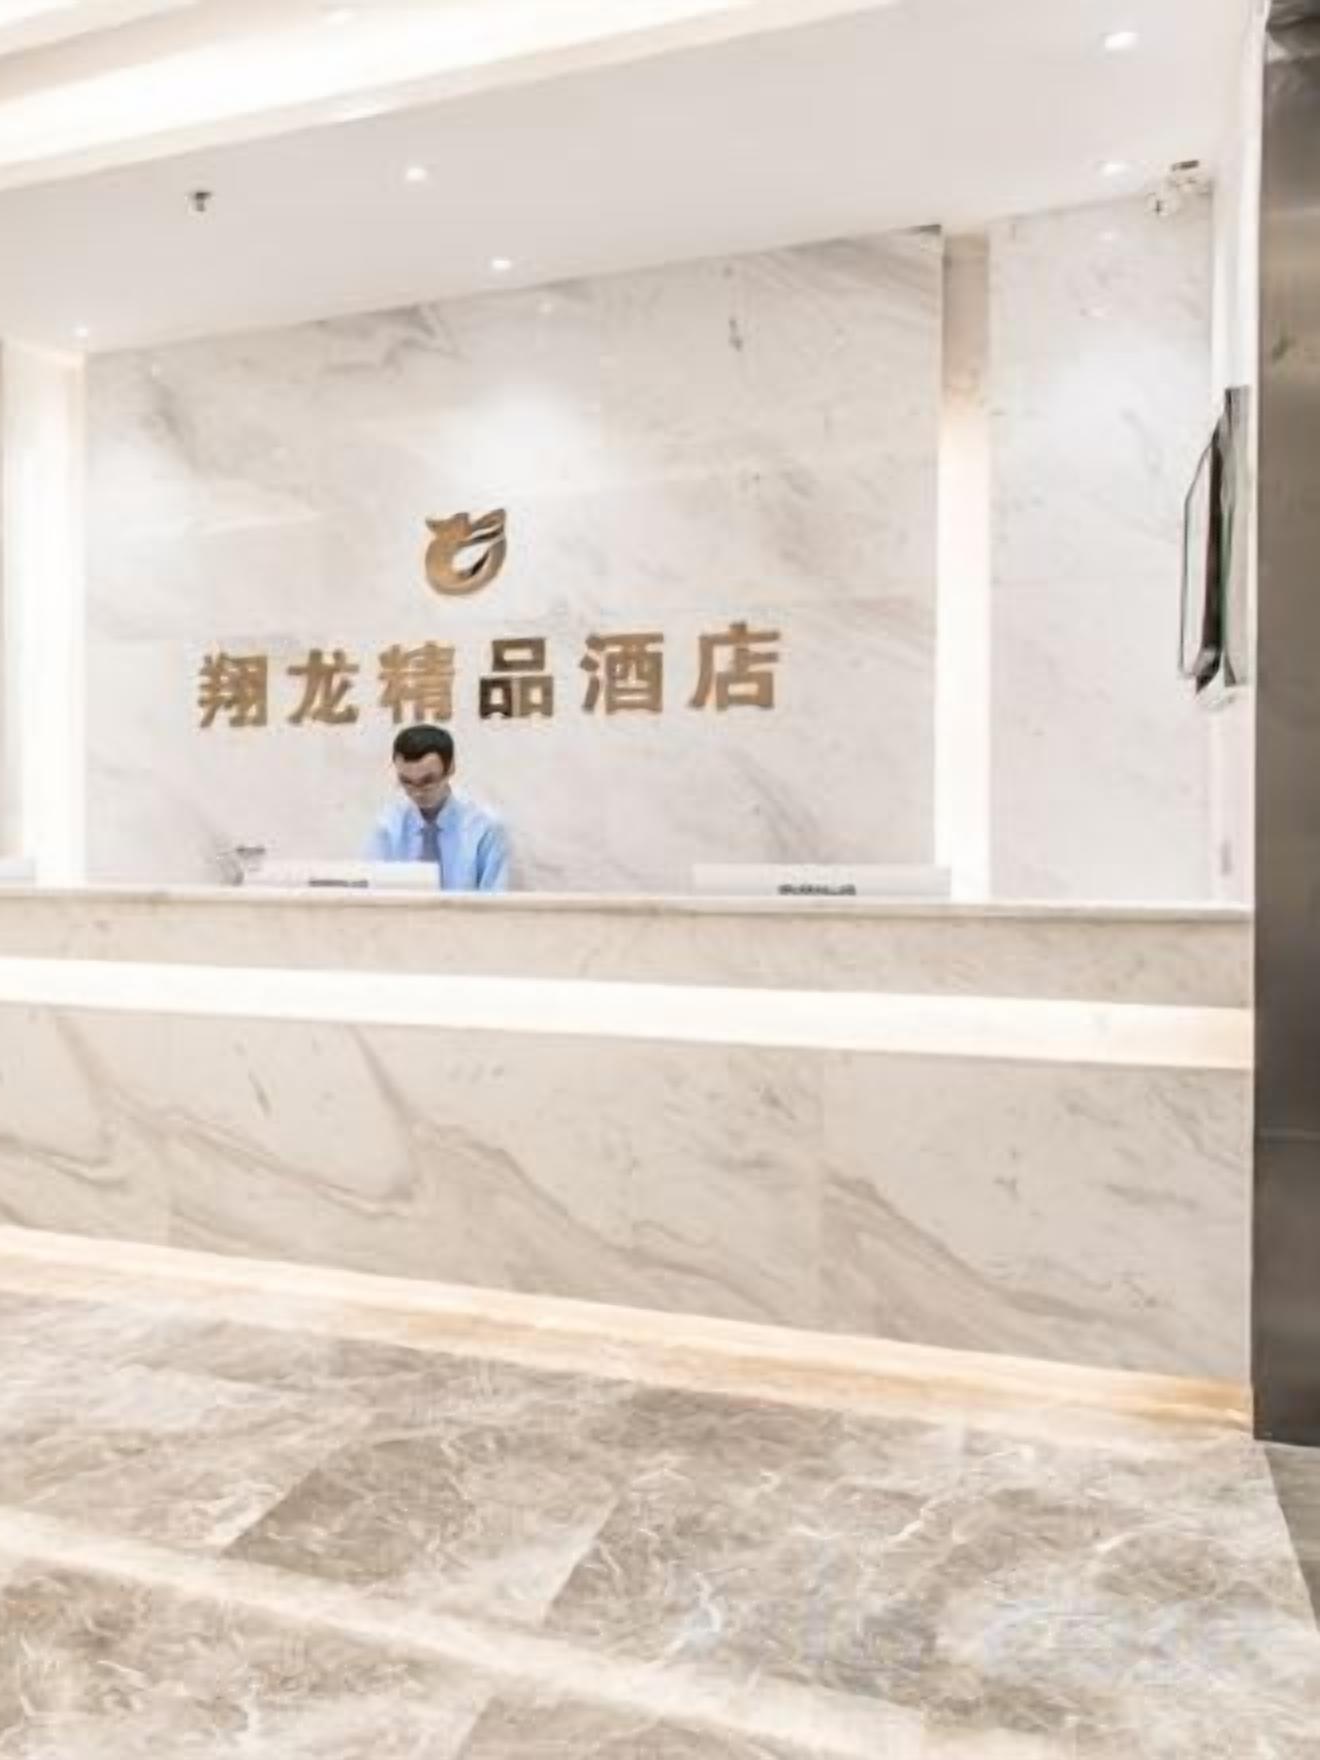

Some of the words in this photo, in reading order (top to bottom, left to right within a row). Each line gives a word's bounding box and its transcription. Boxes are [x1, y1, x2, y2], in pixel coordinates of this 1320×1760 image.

[198, 621, 782, 729] 翔龙精品酒店
